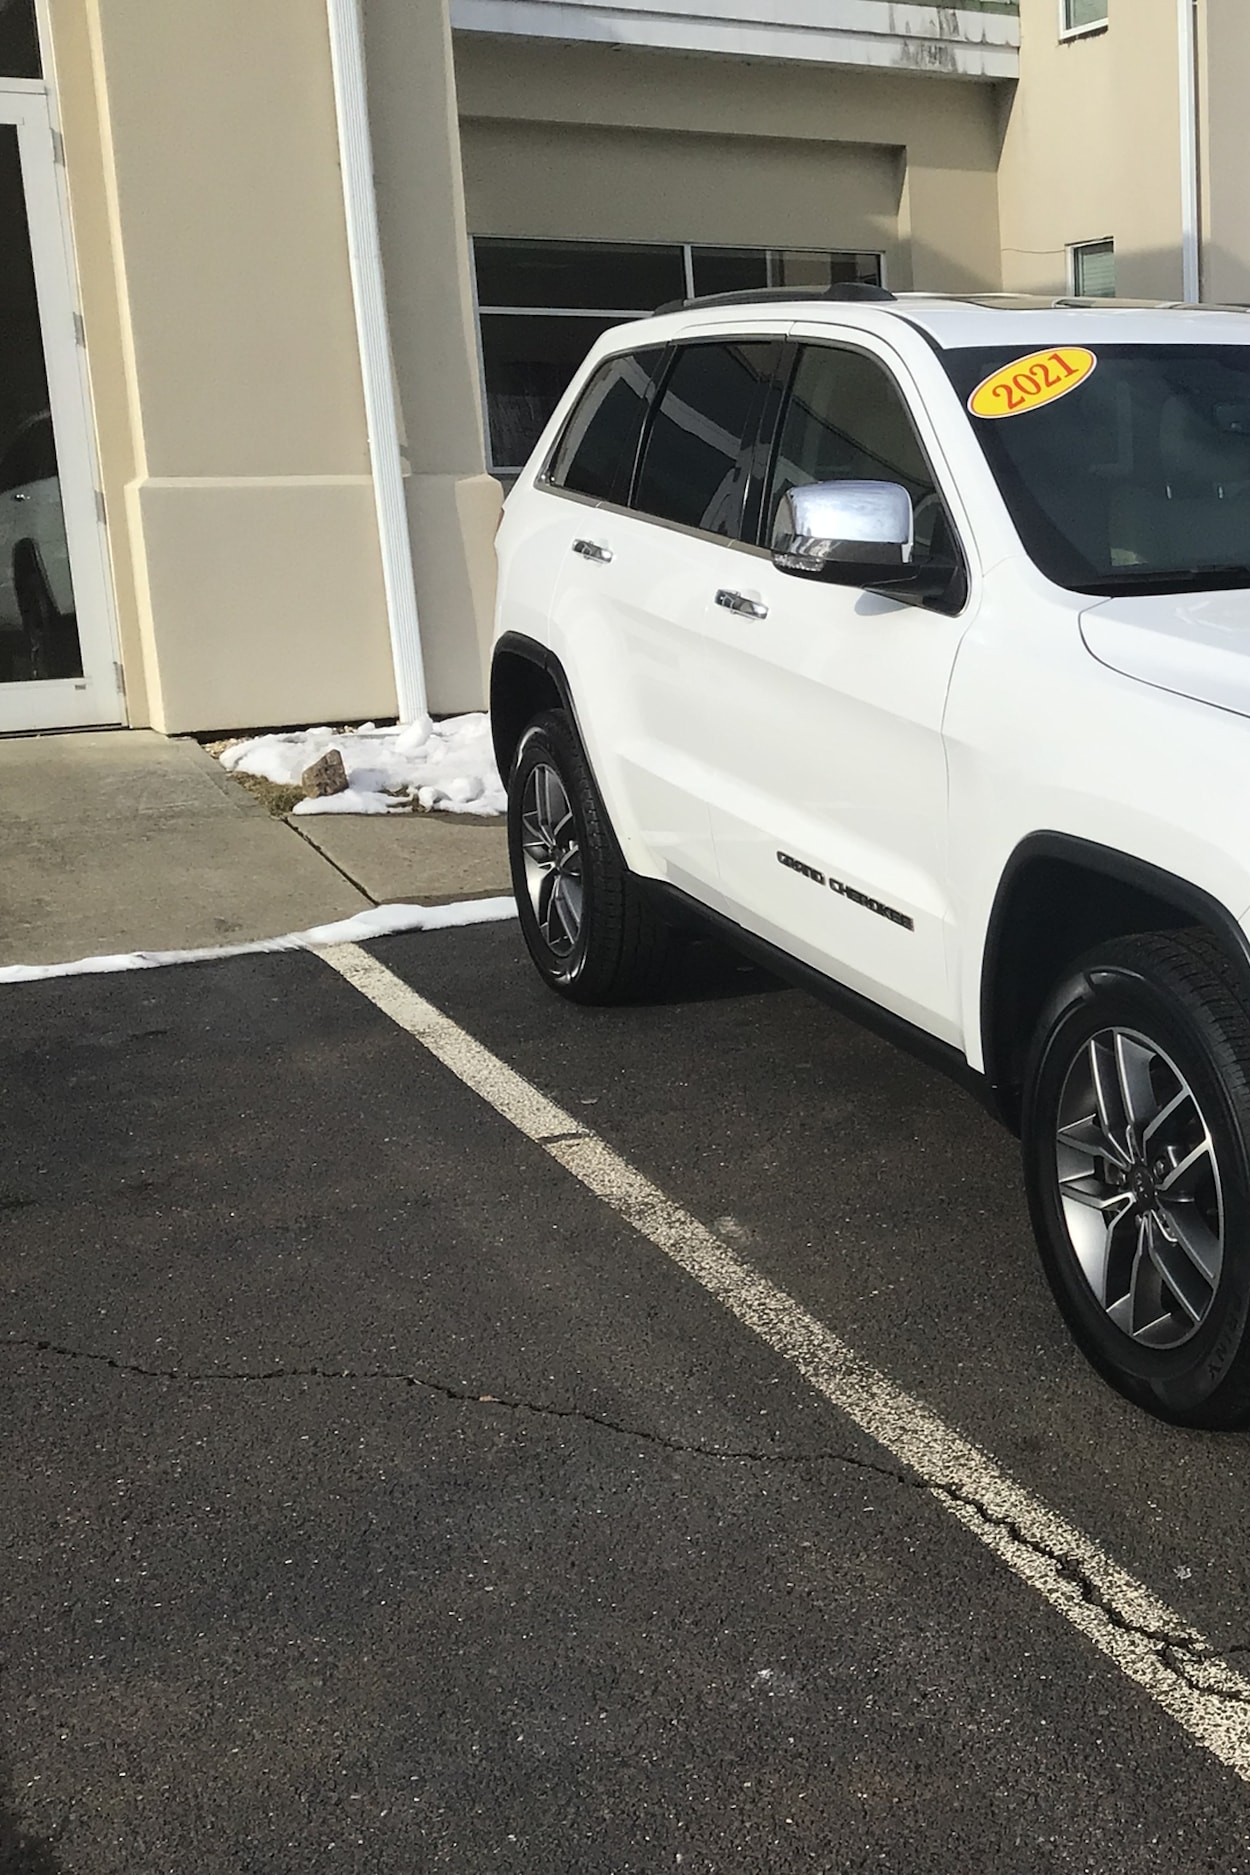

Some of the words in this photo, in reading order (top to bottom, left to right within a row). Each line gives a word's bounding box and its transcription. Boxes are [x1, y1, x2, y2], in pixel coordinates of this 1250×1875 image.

[992, 353, 1079, 410] 2021
[776, 850, 826, 886] GRAND
[829, 877, 914, 932] CHEROKEE
